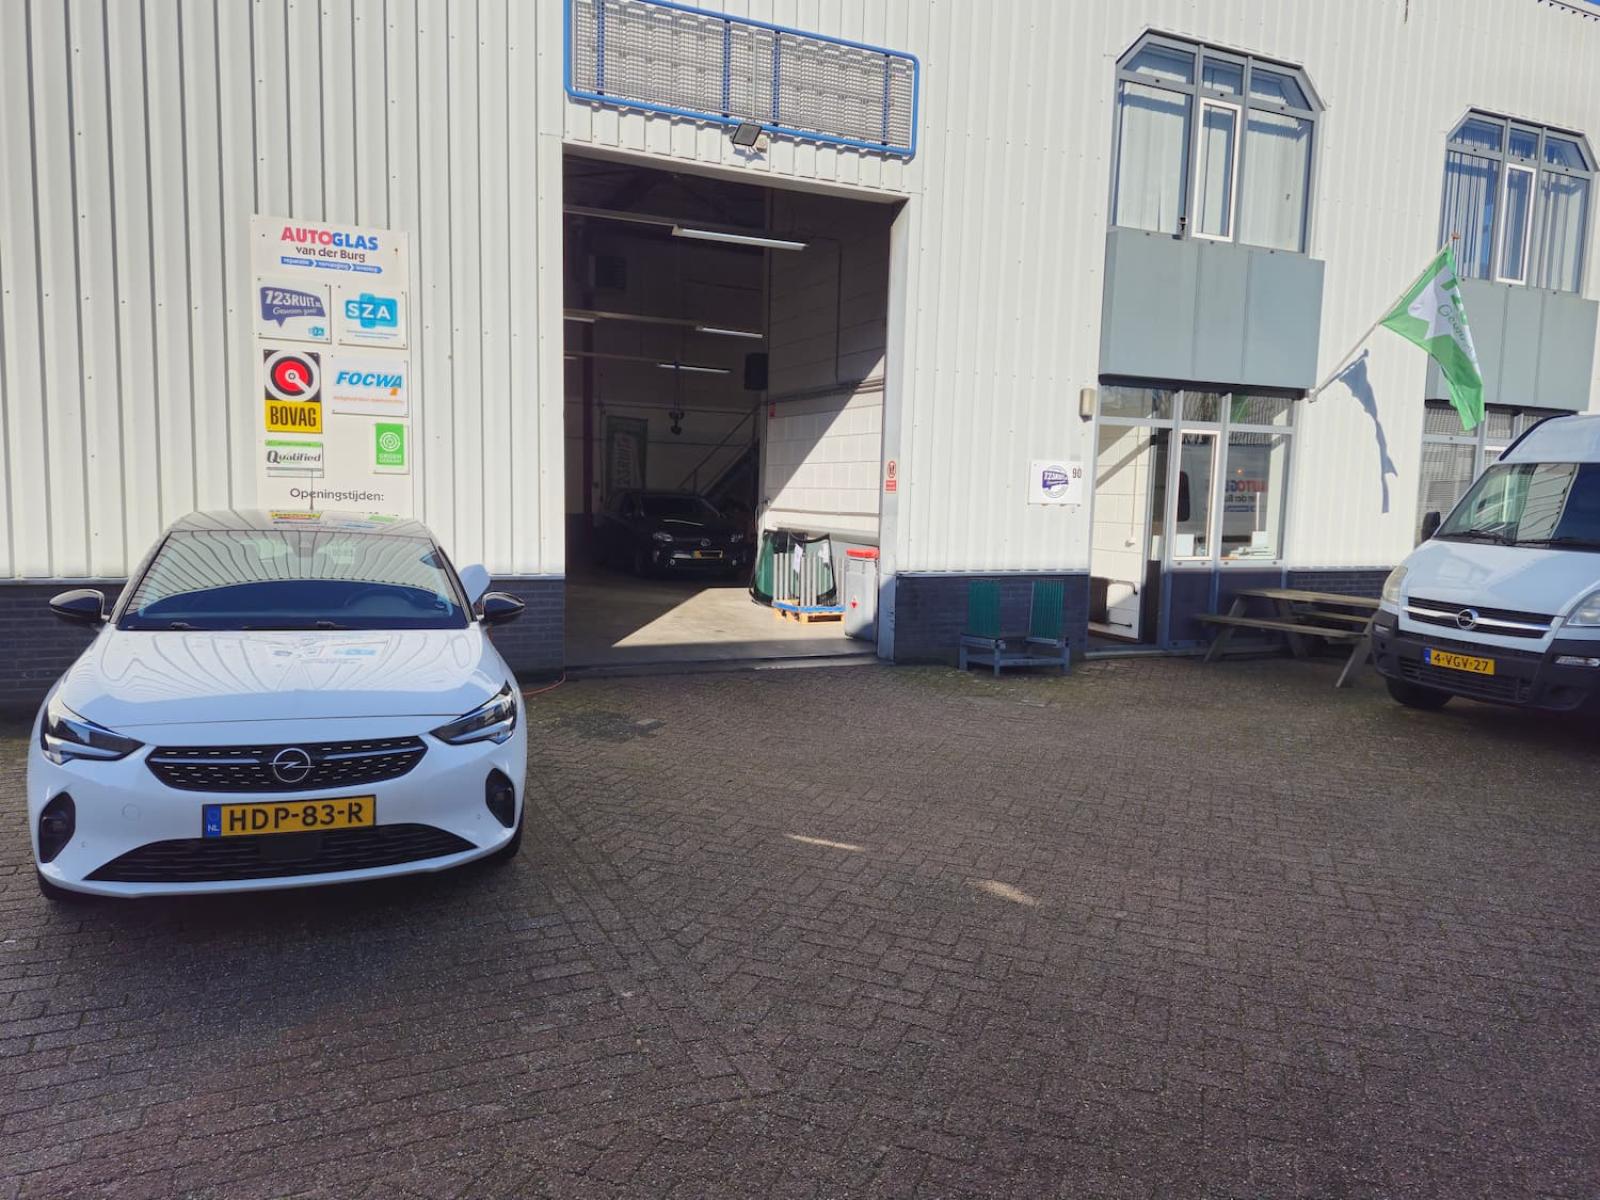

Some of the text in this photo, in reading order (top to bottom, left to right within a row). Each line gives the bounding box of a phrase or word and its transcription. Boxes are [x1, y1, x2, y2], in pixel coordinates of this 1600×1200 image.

[281, 227, 379, 251] AUTOGLAS
[296, 246, 366, 263] van der Burg
[347, 303, 391, 320] SZA
[336, 370, 402, 388] FOCWA
[270, 405, 317, 427] BOVAG
[266, 450, 321, 464] Qualified
[290, 487, 384, 502] Openingstijden:
[229, 802, 363, 832] HDP-83-R
[207, 824, 220, 832] NL
